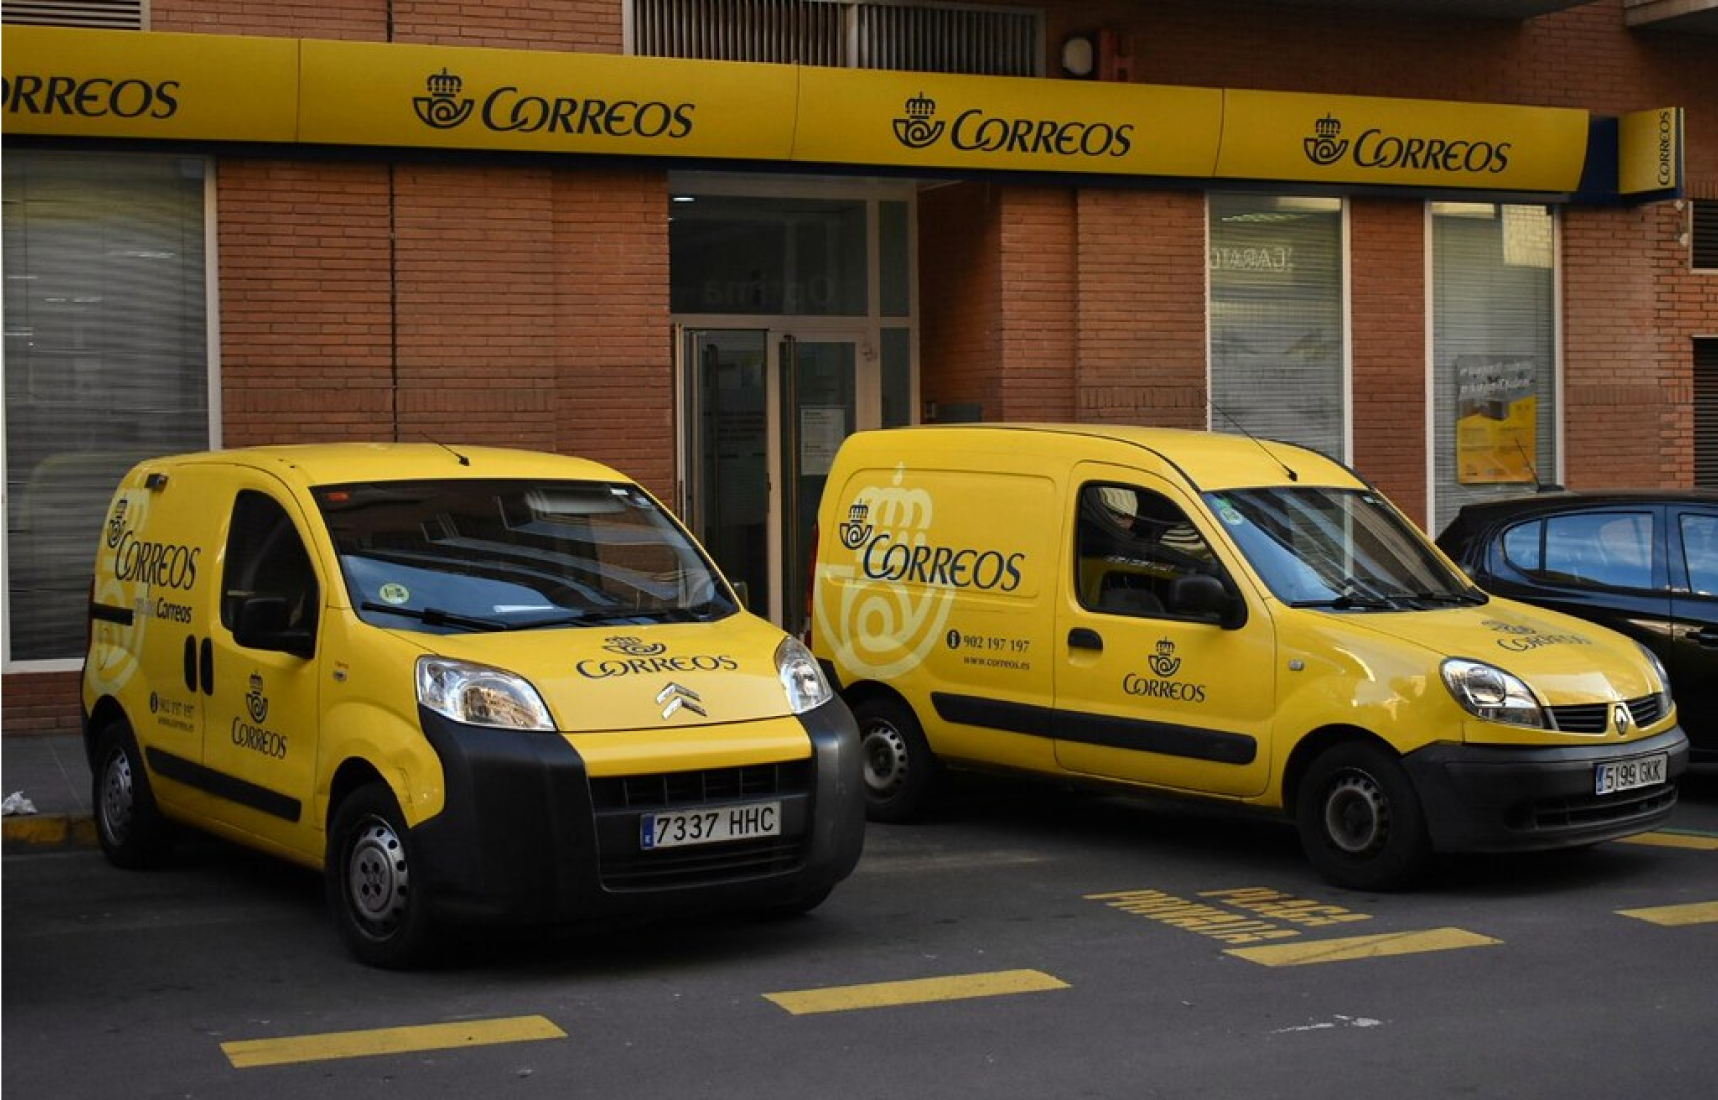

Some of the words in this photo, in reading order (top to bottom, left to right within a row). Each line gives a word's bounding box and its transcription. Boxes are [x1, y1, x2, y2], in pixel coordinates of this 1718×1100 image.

[1, 75, 180, 119] RREOS
[482, 86, 696, 138] CORREOS
[951, 109, 1134, 157] CORREOS
[1353, 128, 1512, 173] CORREOS
[1658, 111, 1671, 186] CORREOS
[115, 530, 201, 590] CORREOS
[863, 534, 1026, 591] CORREOS
[963, 635, 983, 649] 902
[987, 636, 1006, 651] 197
[1010, 639, 1030, 653] 197
[576, 655, 738, 679] CORREOS
[1123, 673, 1206, 703] CORREOS
[232, 716, 287, 759] CORREOS
[1606, 764, 1637, 789] 5199
[656, 812, 719, 845] 7337
[729, 807, 774, 836] HHC
